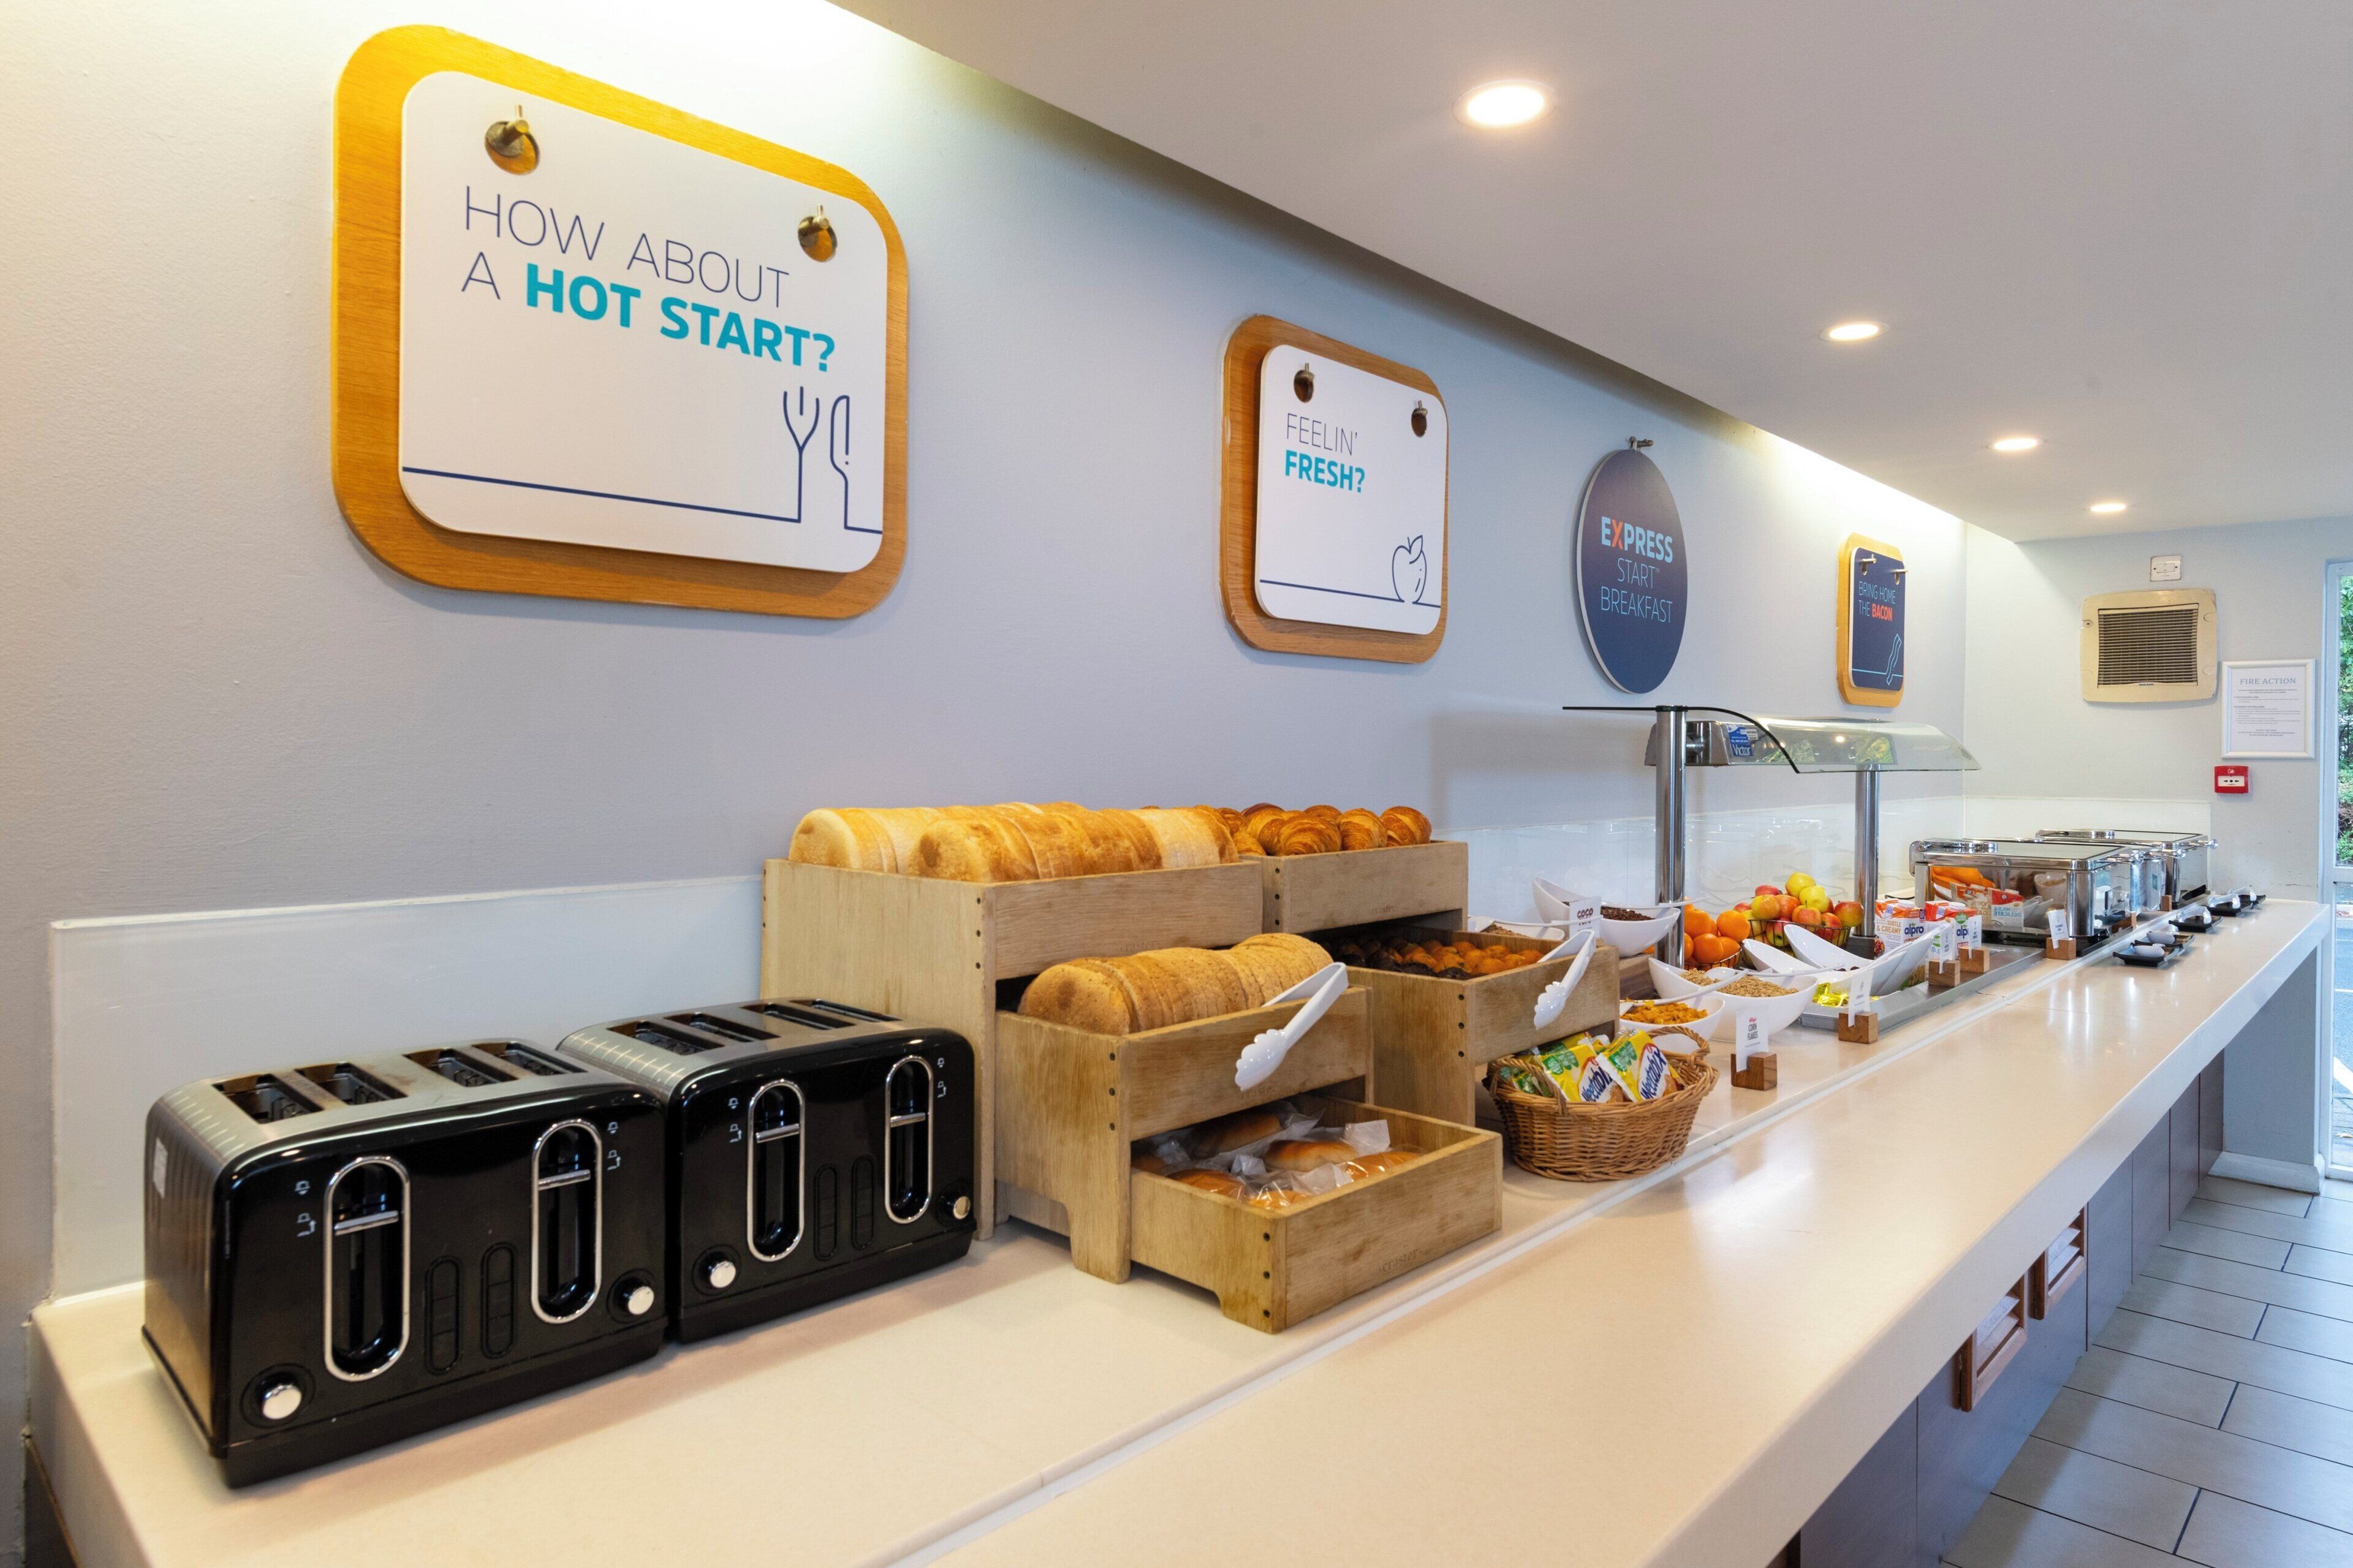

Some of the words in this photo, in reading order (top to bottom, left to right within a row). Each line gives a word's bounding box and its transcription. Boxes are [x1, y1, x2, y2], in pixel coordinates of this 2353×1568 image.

[466, 185, 605, 261] HOW
[626, 233, 790, 308] ABOUT
[461, 251, 501, 300] A
[526, 262, 642, 328] HOT
[659, 296, 836, 372] START?
[1287, 413, 1358, 455] FEELIN'
[1284, 449, 1366, 493] FRESH?
[1601, 516, 1673, 563] EXPRESS
[1601, 586, 1673, 623] BREAKFAST
[1858, 599, 1870, 616] THE
[1871, 603, 1893, 622] BACON
[1859, 581, 1878, 599] BRING
[1879, 586, 1896, 604] HOME
[1732, 744, 1751, 756] Victor
[1577, 907, 1594, 918] COCO
[1904, 923, 1924, 937] alpro
[1956, 925, 1969, 939] alp
[1640, 1045, 1667, 1100] Weetabix
